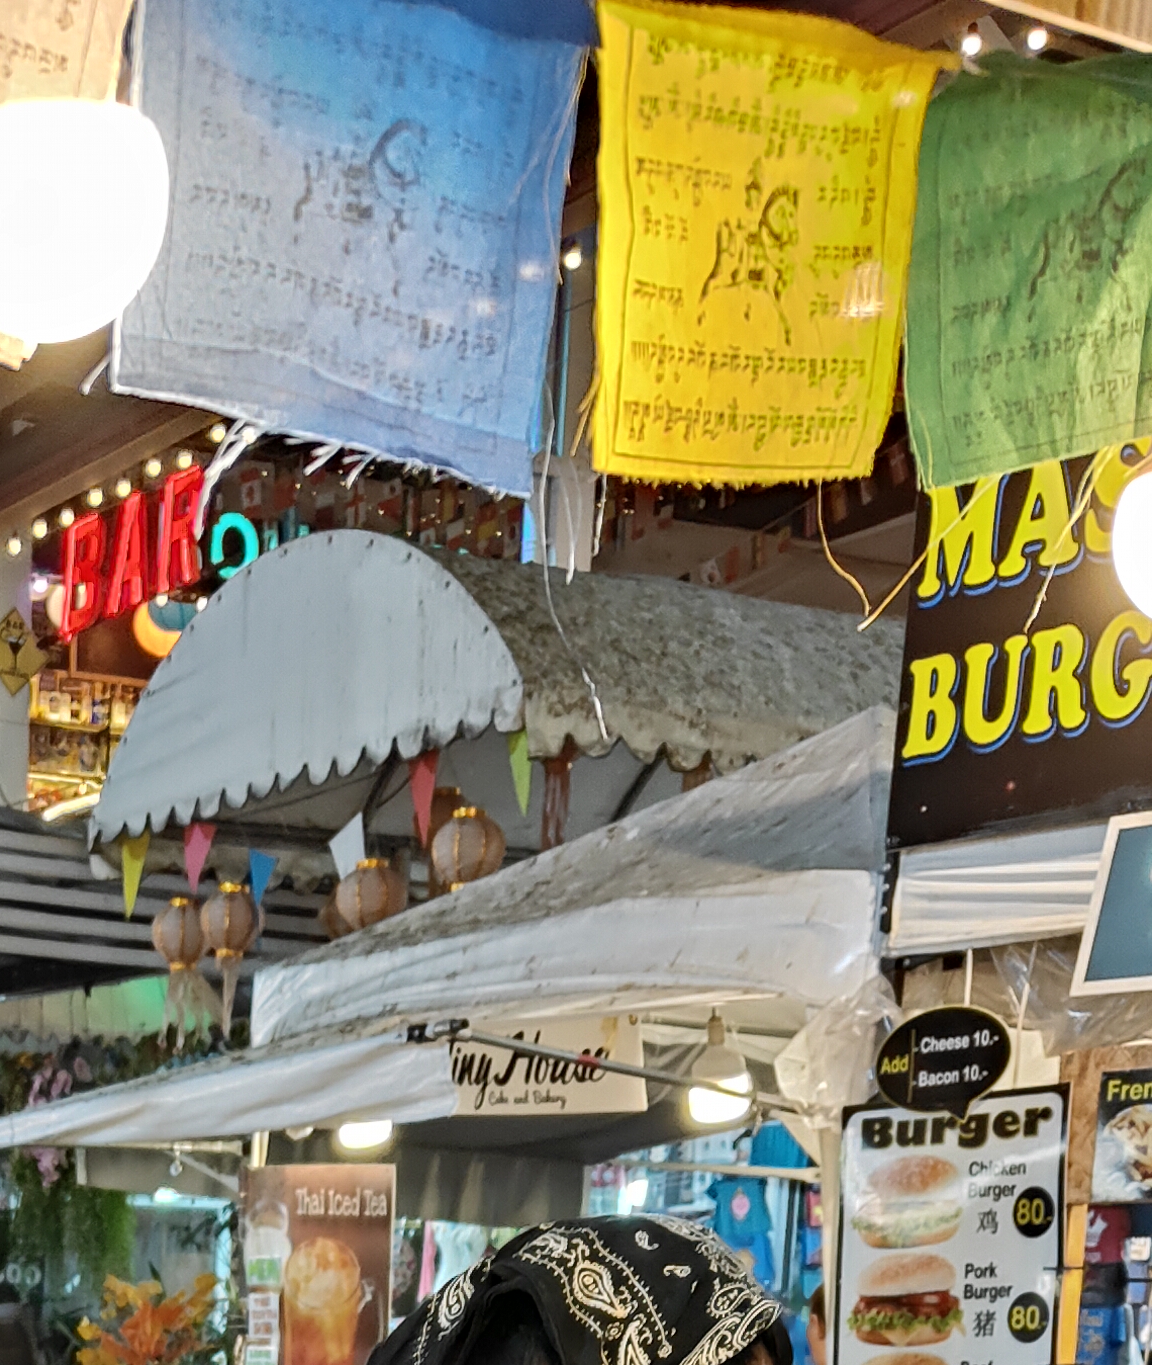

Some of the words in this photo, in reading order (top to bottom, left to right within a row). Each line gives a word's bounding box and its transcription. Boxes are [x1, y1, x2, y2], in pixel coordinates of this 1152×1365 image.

[60, 464, 205, 645] BAR
[920, 1035, 970, 1054] Cheese
[880, 1055, 909, 1075] Add
[918, 1069, 960, 1088] Bacon
[861, 1105, 1054, 1150] Burger
[968, 1160, 1027, 1177] Chicken
[968, 1182, 1017, 1200] Burger
[296, 1187, 325, 1216] Thai
[328, 1187, 361, 1217] Iced
[363, 1189, 388, 1217] Tea
[964, 1262, 998, 1280] Pork
[963, 1284, 1013, 1303] Burger
